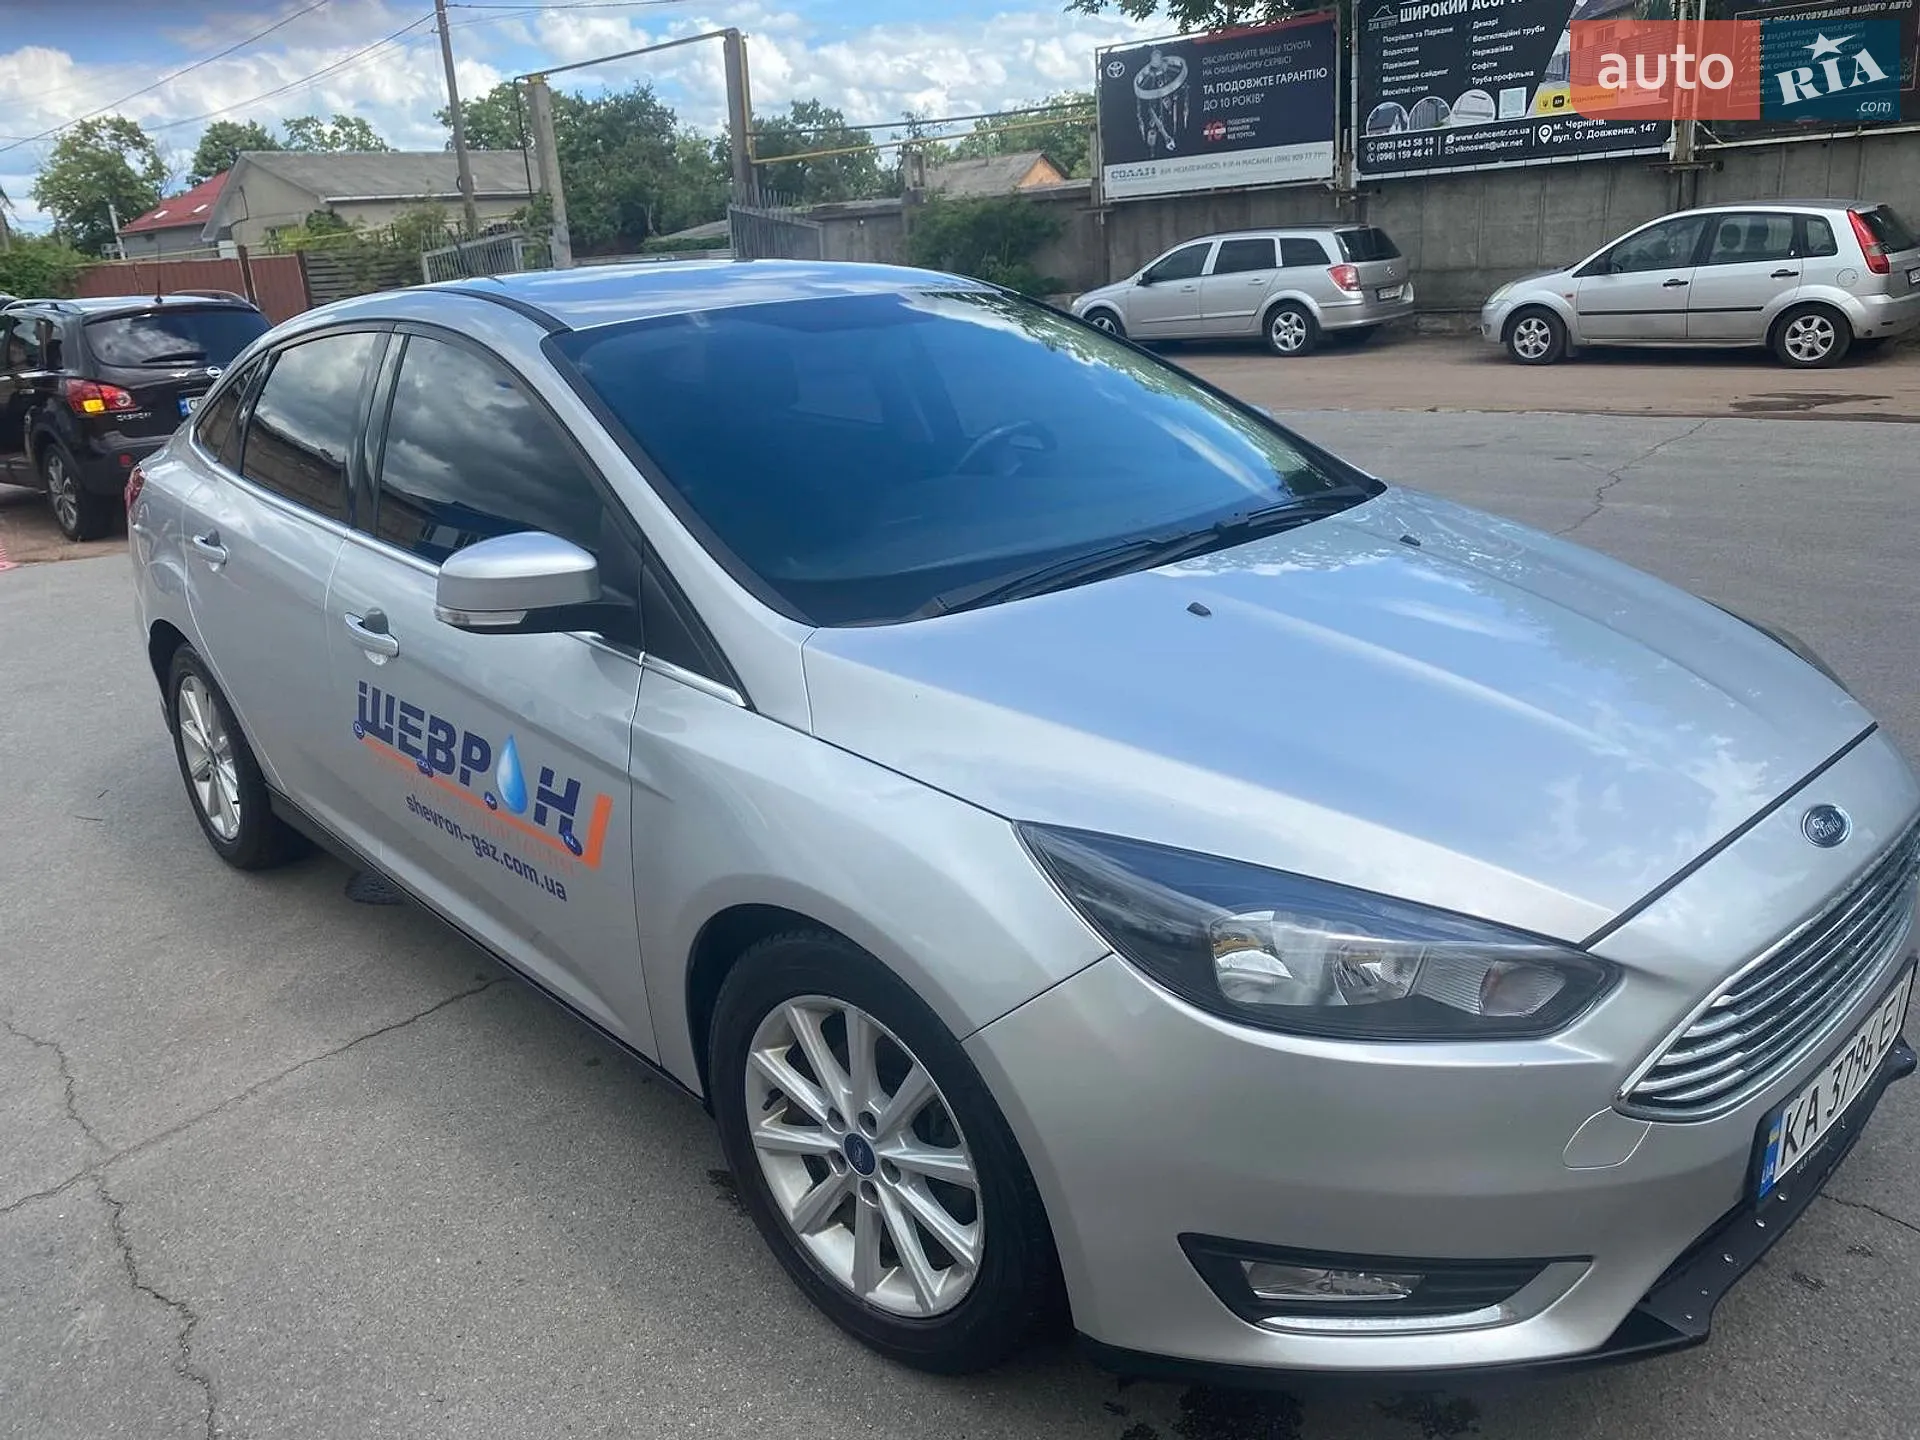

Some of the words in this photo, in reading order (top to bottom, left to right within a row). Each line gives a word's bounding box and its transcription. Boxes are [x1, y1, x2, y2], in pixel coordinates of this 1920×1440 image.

[1400, 0, 1468, 23] ШИРОКИЙ
[1415, 31, 1423, 39] та
[1522, 25, 1546, 37] труби
[1471, 60, 1498, 71] Софіти
[1203, 84, 1215, 95] ТА
[1216, 74, 1274, 93] ПОДОВЖТЕ
[1275, 67, 1328, 84] ГАРАНТІЮ
[1471, 75, 1492, 86] Труба
[1493, 70, 1534, 83] профільна
[1203, 99, 1218, 112] ДО
[1219, 97, 1230, 109] 10
[1552, 123, 1563, 131] м.
[1552, 133, 1572, 144] вул.
[1574, 130, 1585, 141] О.
[1586, 125, 1637, 141] Довженка,
[1639, 122, 1657, 133] 147
[405, 793, 568, 903] shevron-gaz.com.ua
[1780, 1085, 1820, 1166] KA
[1826, 1016, 1878, 1118] 3796
